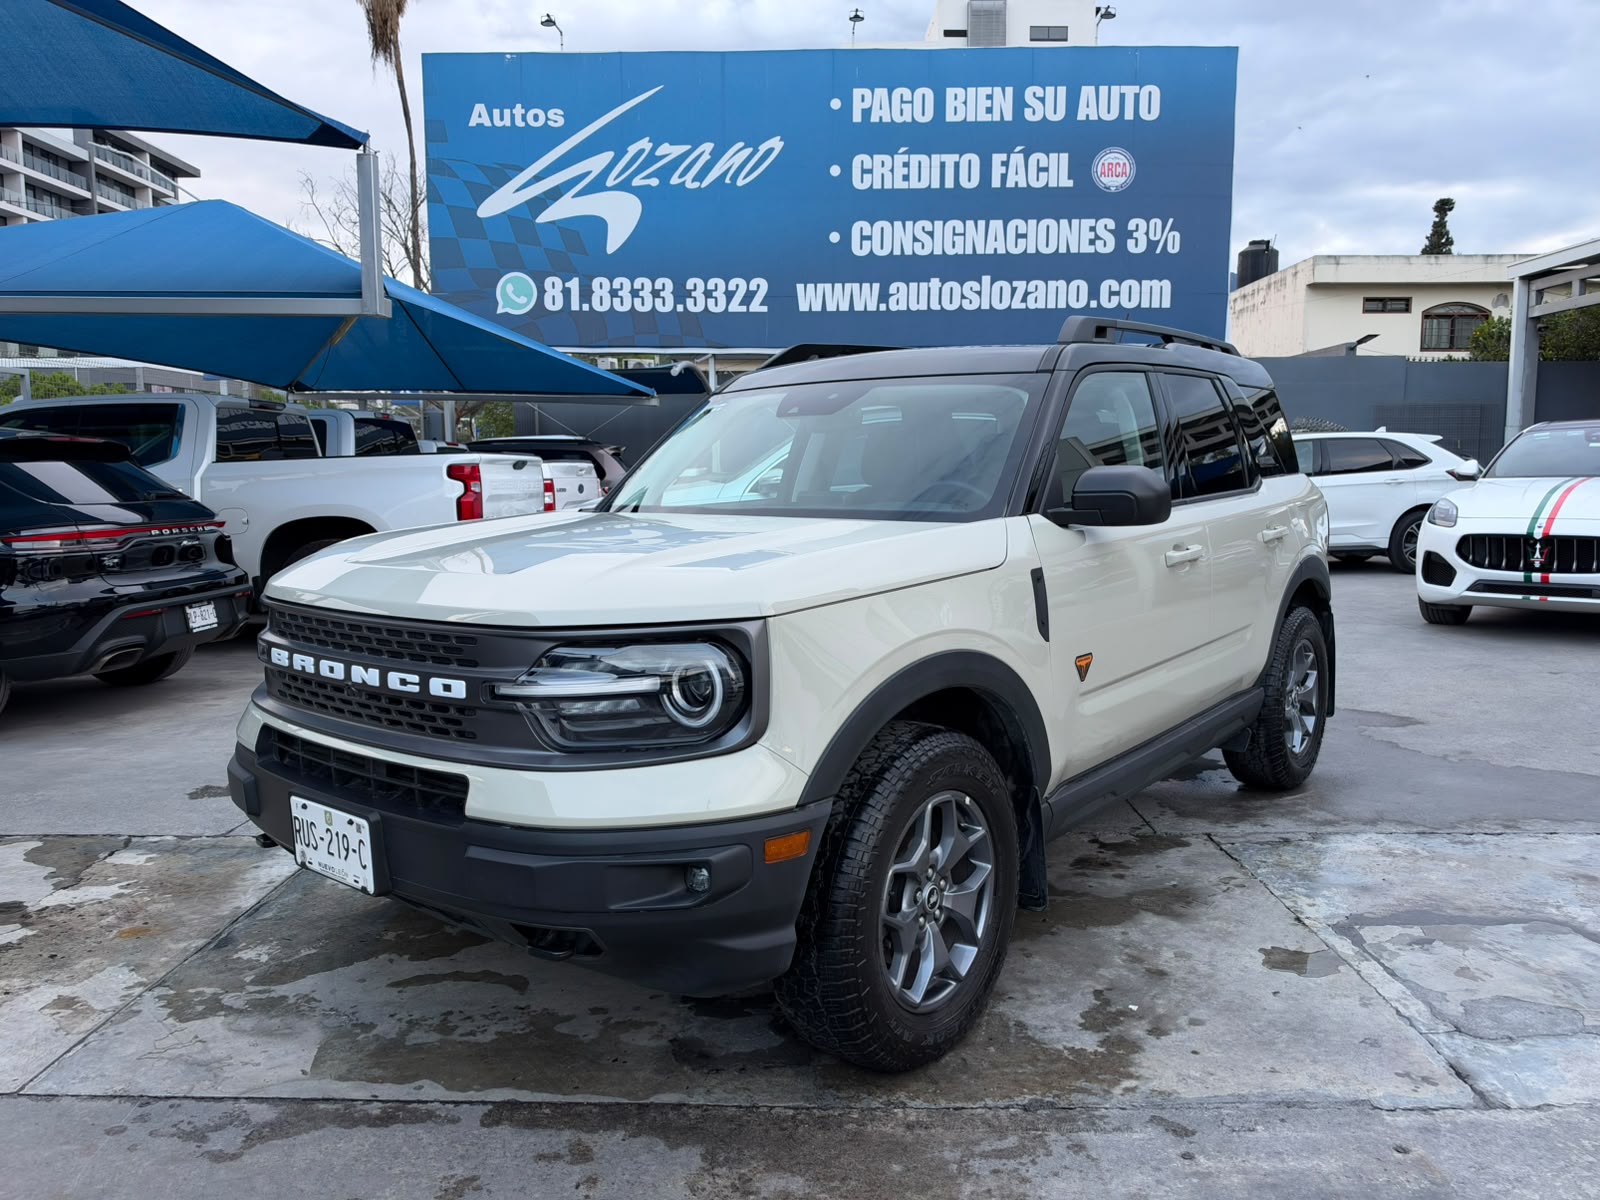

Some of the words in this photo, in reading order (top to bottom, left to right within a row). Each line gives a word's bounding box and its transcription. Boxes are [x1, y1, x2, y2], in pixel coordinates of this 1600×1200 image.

[469, 103, 565, 128] Autos
[852, 87, 935, 123] PAGO
[945, 86, 1014, 122] BIEN
[1023, 86, 1067, 121] SU
[1076, 85, 1161, 121] AUTO
[476, 85, 785, 255] Lozano
[851, 147, 981, 190] CRÉDITO
[991, 146, 1074, 189] FÁCIL
[1100, 161, 1128, 178] ARCA
[851, 217, 1116, 256] CONSIGNACIONES
[1126, 217, 1181, 254] 3%
[543, 276, 769, 313] 81.8333.3322
[795, 275, 1172, 312] www.autoslozano.com
[151, 526, 210, 535] PORSCHE
[270, 647, 467, 700] BRONCO
[293, 815, 368, 870] RUS-219-C
